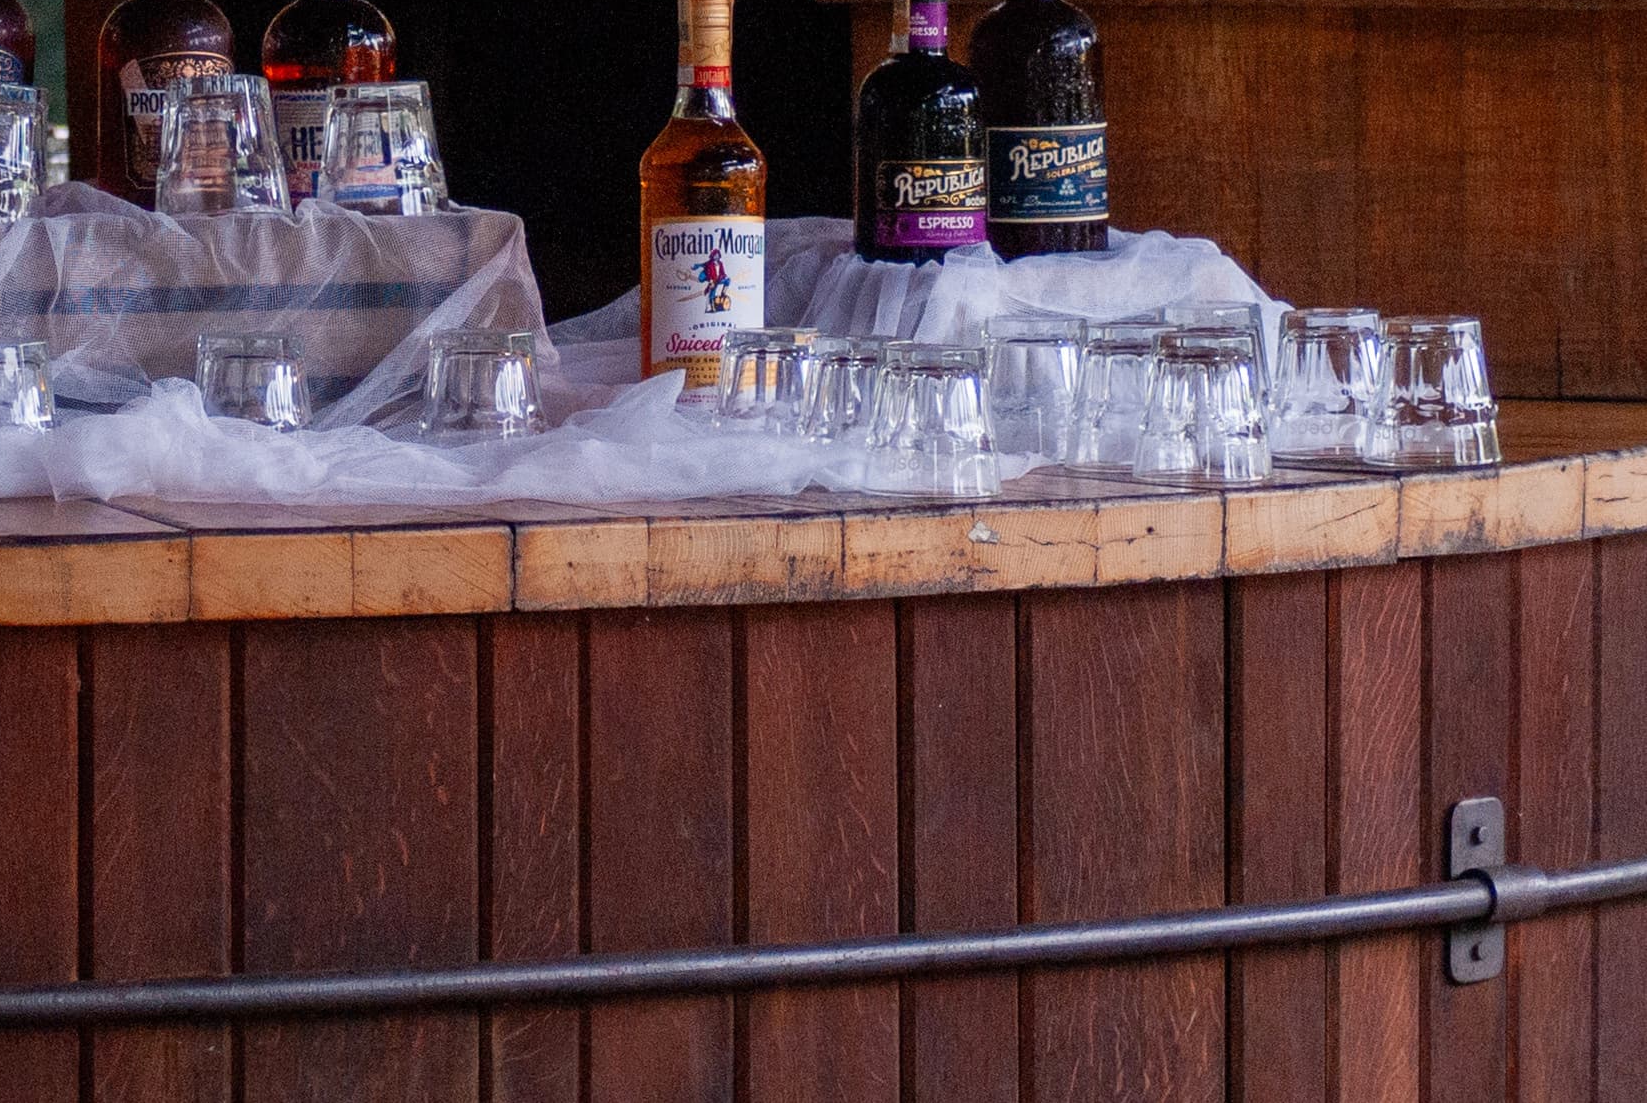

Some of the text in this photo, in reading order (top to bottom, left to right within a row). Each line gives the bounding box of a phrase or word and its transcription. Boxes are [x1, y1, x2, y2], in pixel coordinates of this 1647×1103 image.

[918, 216, 974, 229] ESPRESSO
[655, 227, 714, 261] Captain
[665, 332, 725, 355] Spiced
